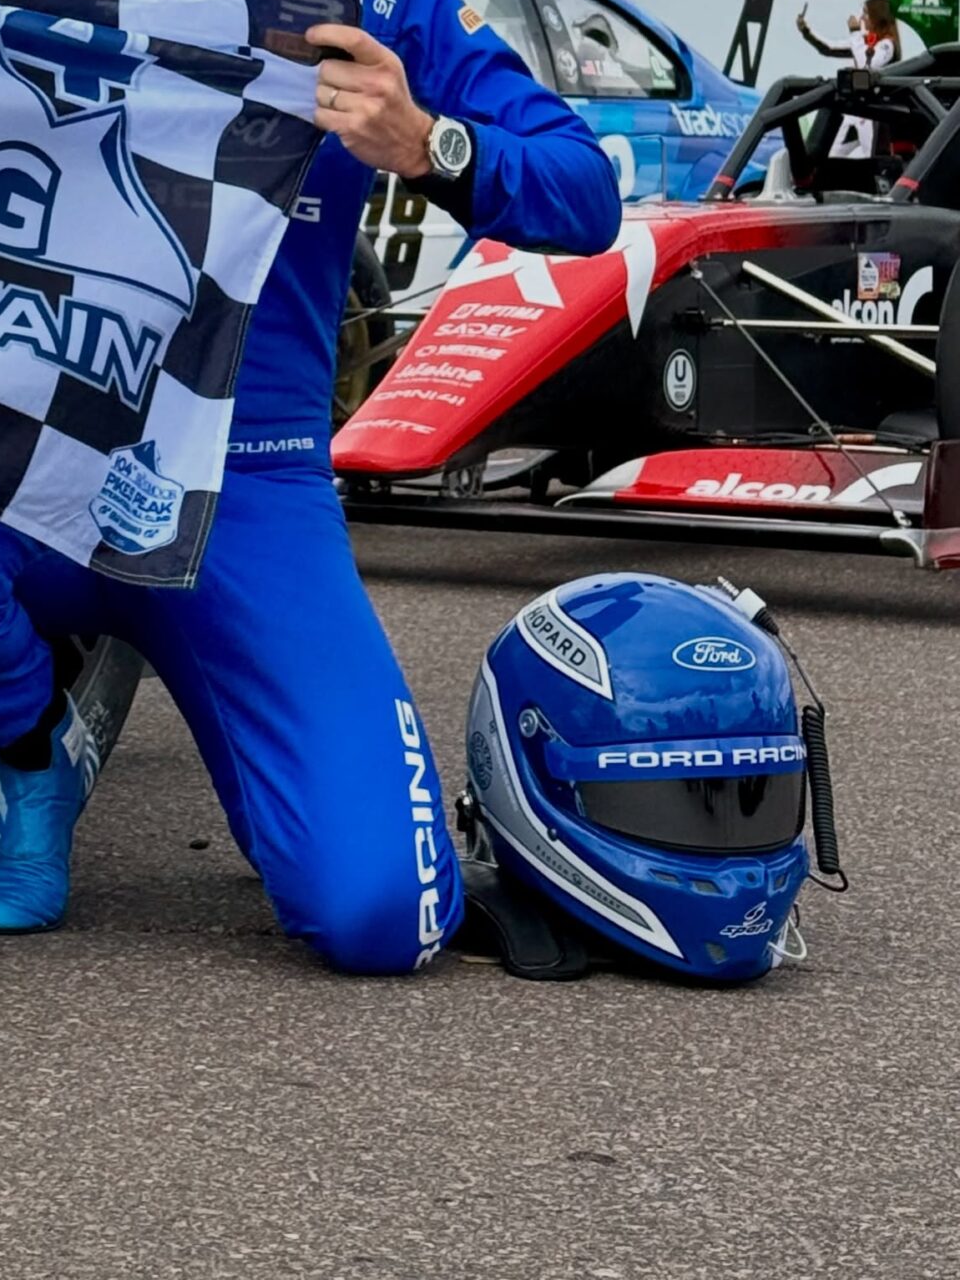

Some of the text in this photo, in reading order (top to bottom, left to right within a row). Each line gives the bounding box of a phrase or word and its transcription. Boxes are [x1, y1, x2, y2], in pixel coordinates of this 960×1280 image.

[433, 322, 528, 338] SADEV
[685, 472, 832, 503] alcon
[692, 641, 742, 665] Ford
[598, 750, 724, 769] FORD
